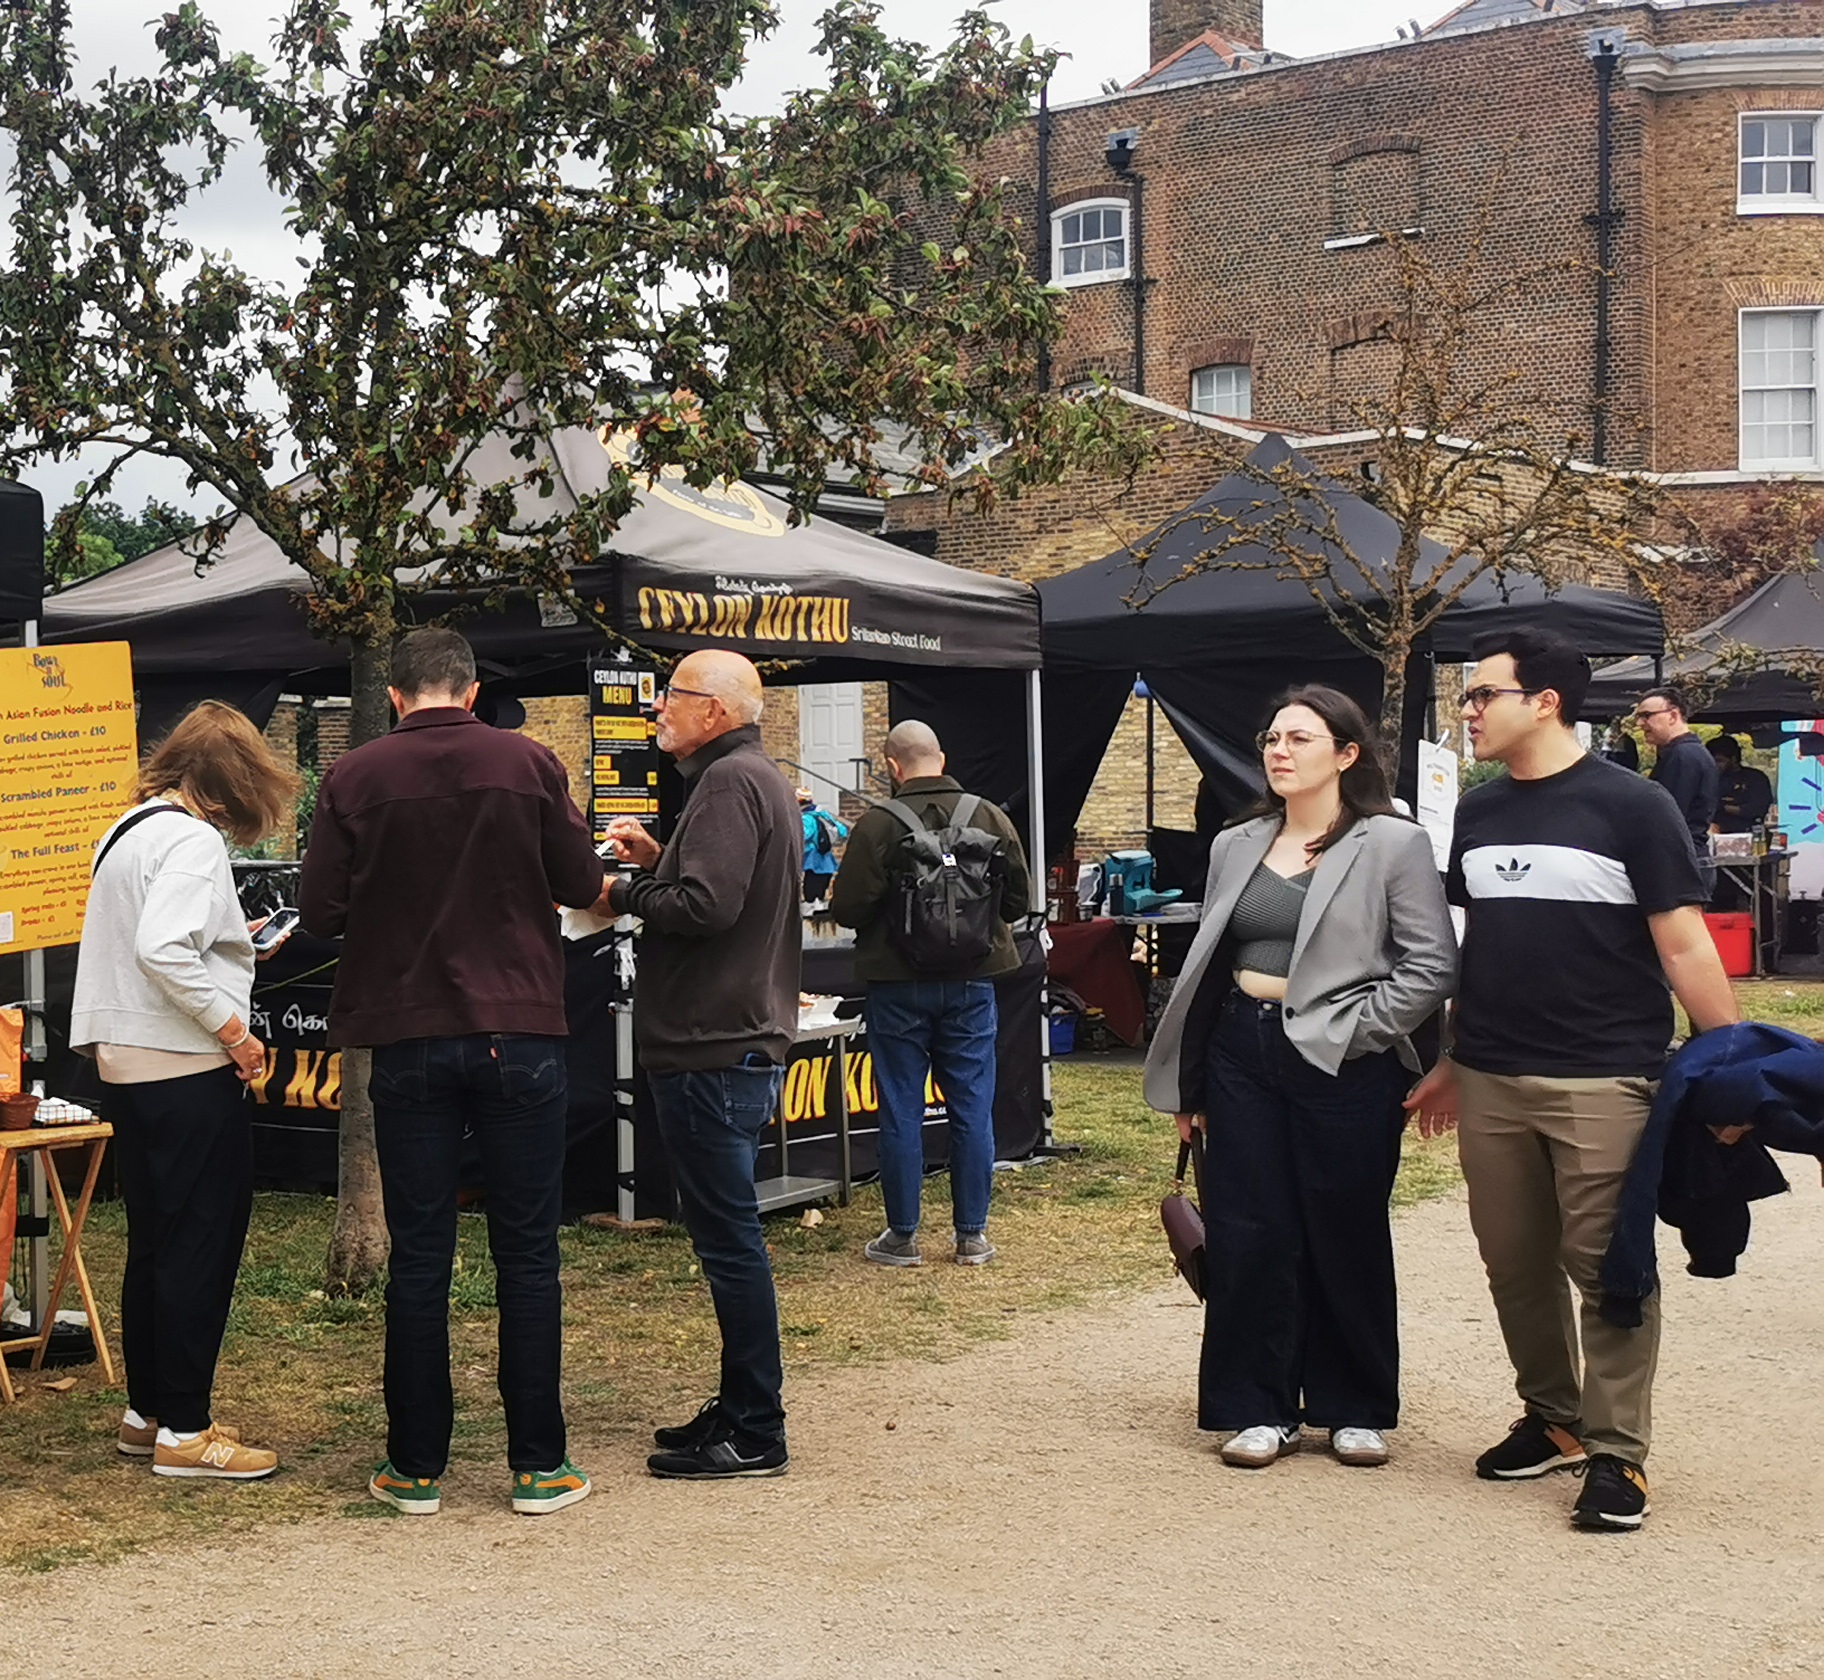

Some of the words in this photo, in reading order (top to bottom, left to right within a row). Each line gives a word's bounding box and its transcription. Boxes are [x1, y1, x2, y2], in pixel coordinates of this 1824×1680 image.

[637, 586, 753, 639] CEYLON
[754, 594, 850, 644] KOTHU
[919, 634, 942, 652] Food
[602, 685, 632, 706] MENU
[6, 709, 31, 720] Asian
[33, 706, 61, 718] Fusion
[63, 701, 94, 715] Noodle
[96, 701, 113, 713] and
[115, 699, 132, 711] Rice
[3, 731, 38, 745] Grilled
[41, 728, 80, 741] Chicken
[90, 725, 107, 736] £10
[1, 787, 53, 803] Scrambled
[55, 785, 90, 797] Paneer
[99, 781, 117, 792] £10
[11, 849, 30, 860] The
[32, 844, 51, 857] Full
[54, 841, 80, 854] Feast
